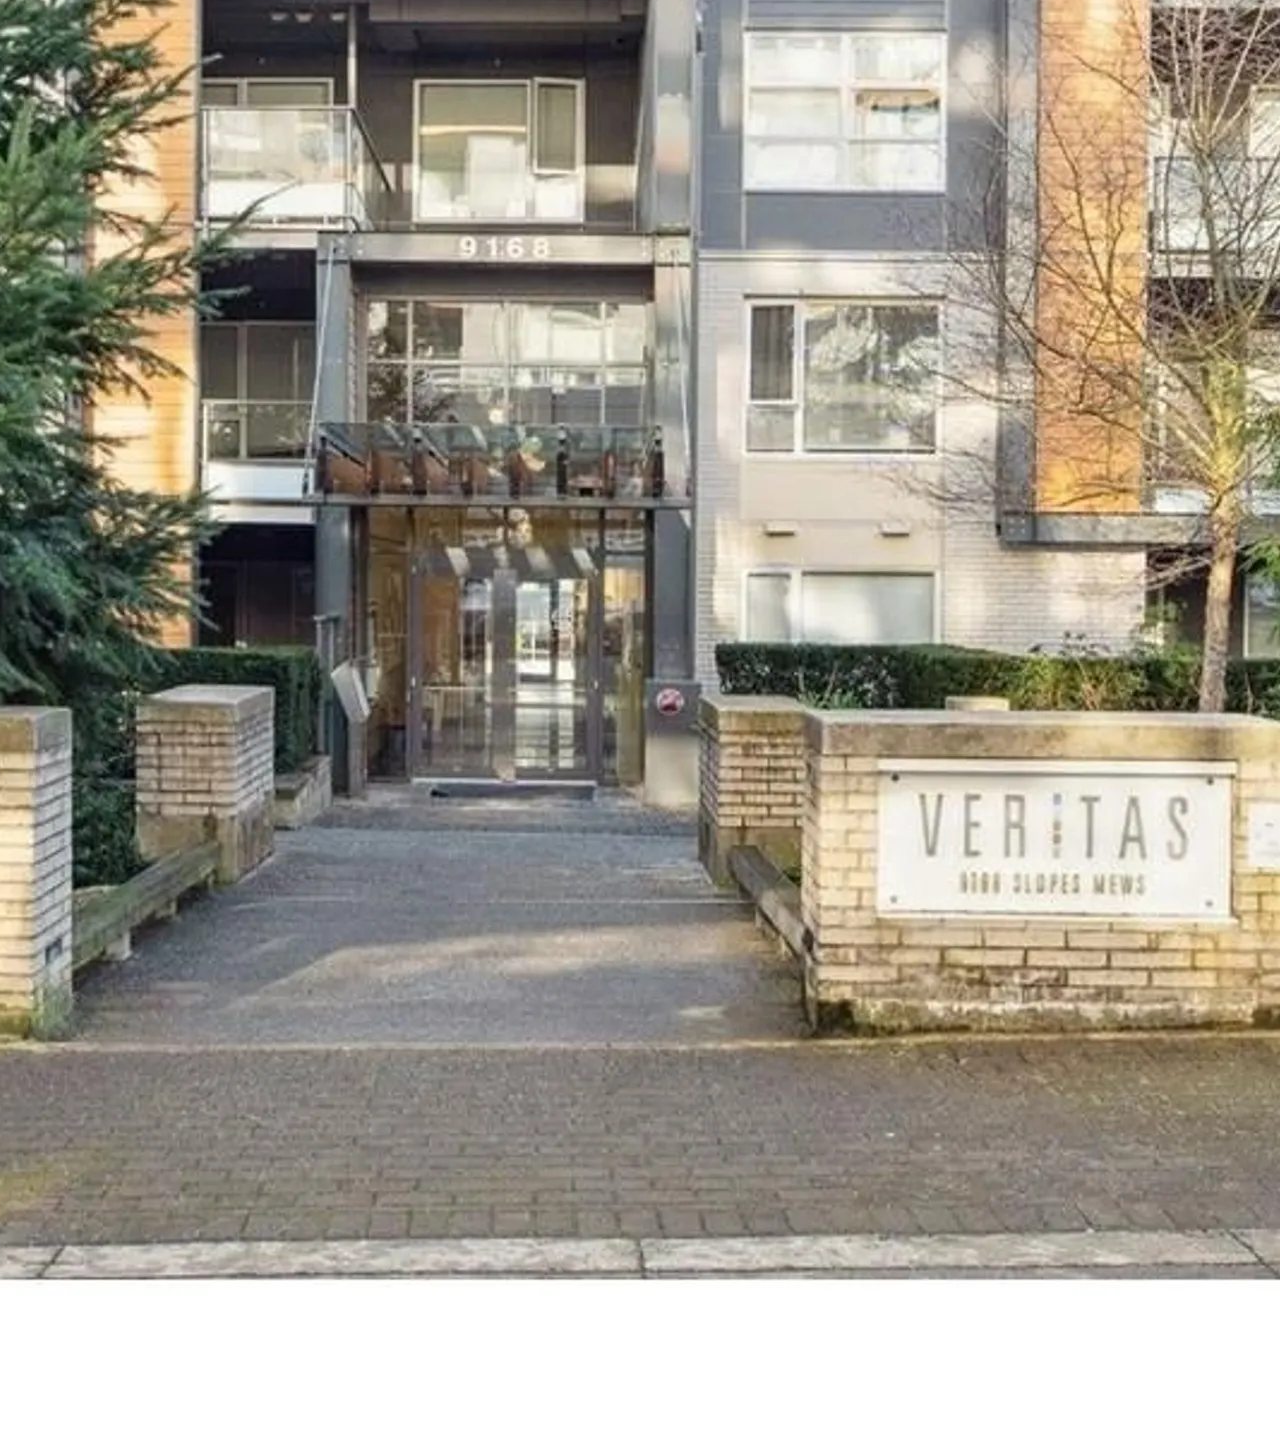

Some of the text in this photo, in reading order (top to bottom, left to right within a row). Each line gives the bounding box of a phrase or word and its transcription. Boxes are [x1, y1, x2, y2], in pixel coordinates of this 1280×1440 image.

[459, 235, 550, 259] 9168
[1012, 872, 1081, 895] SLOPES
[1092, 872, 1147, 896] MEWS
